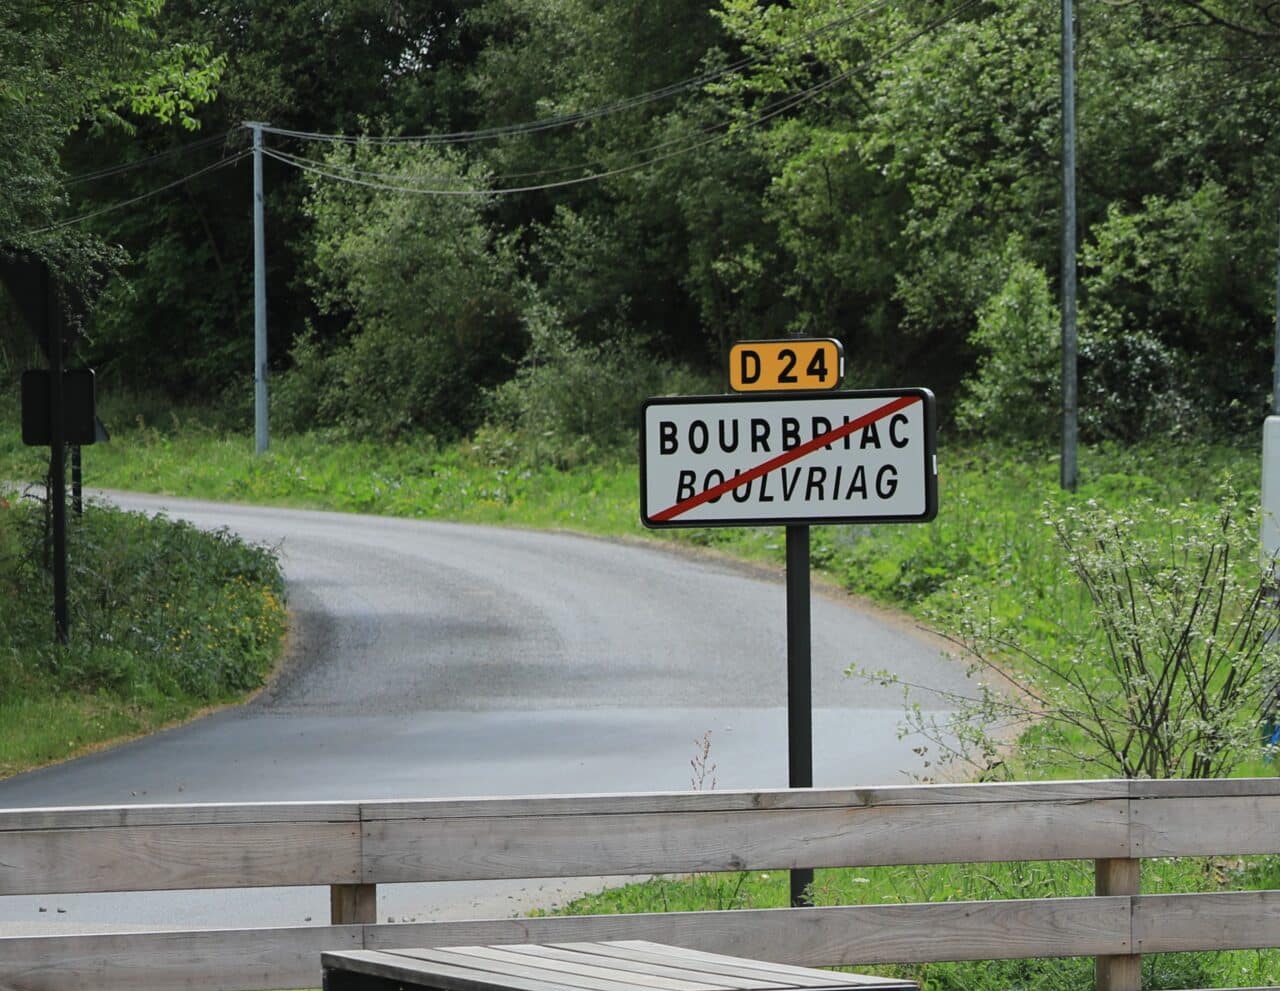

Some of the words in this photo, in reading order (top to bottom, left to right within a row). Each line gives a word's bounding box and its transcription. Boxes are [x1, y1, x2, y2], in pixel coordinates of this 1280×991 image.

[741, 350, 761, 384] D
[777, 348, 828, 383] 24
[659, 413, 909, 455] BOURBRIAC
[676, 464, 898, 504] BOULVRIAG
